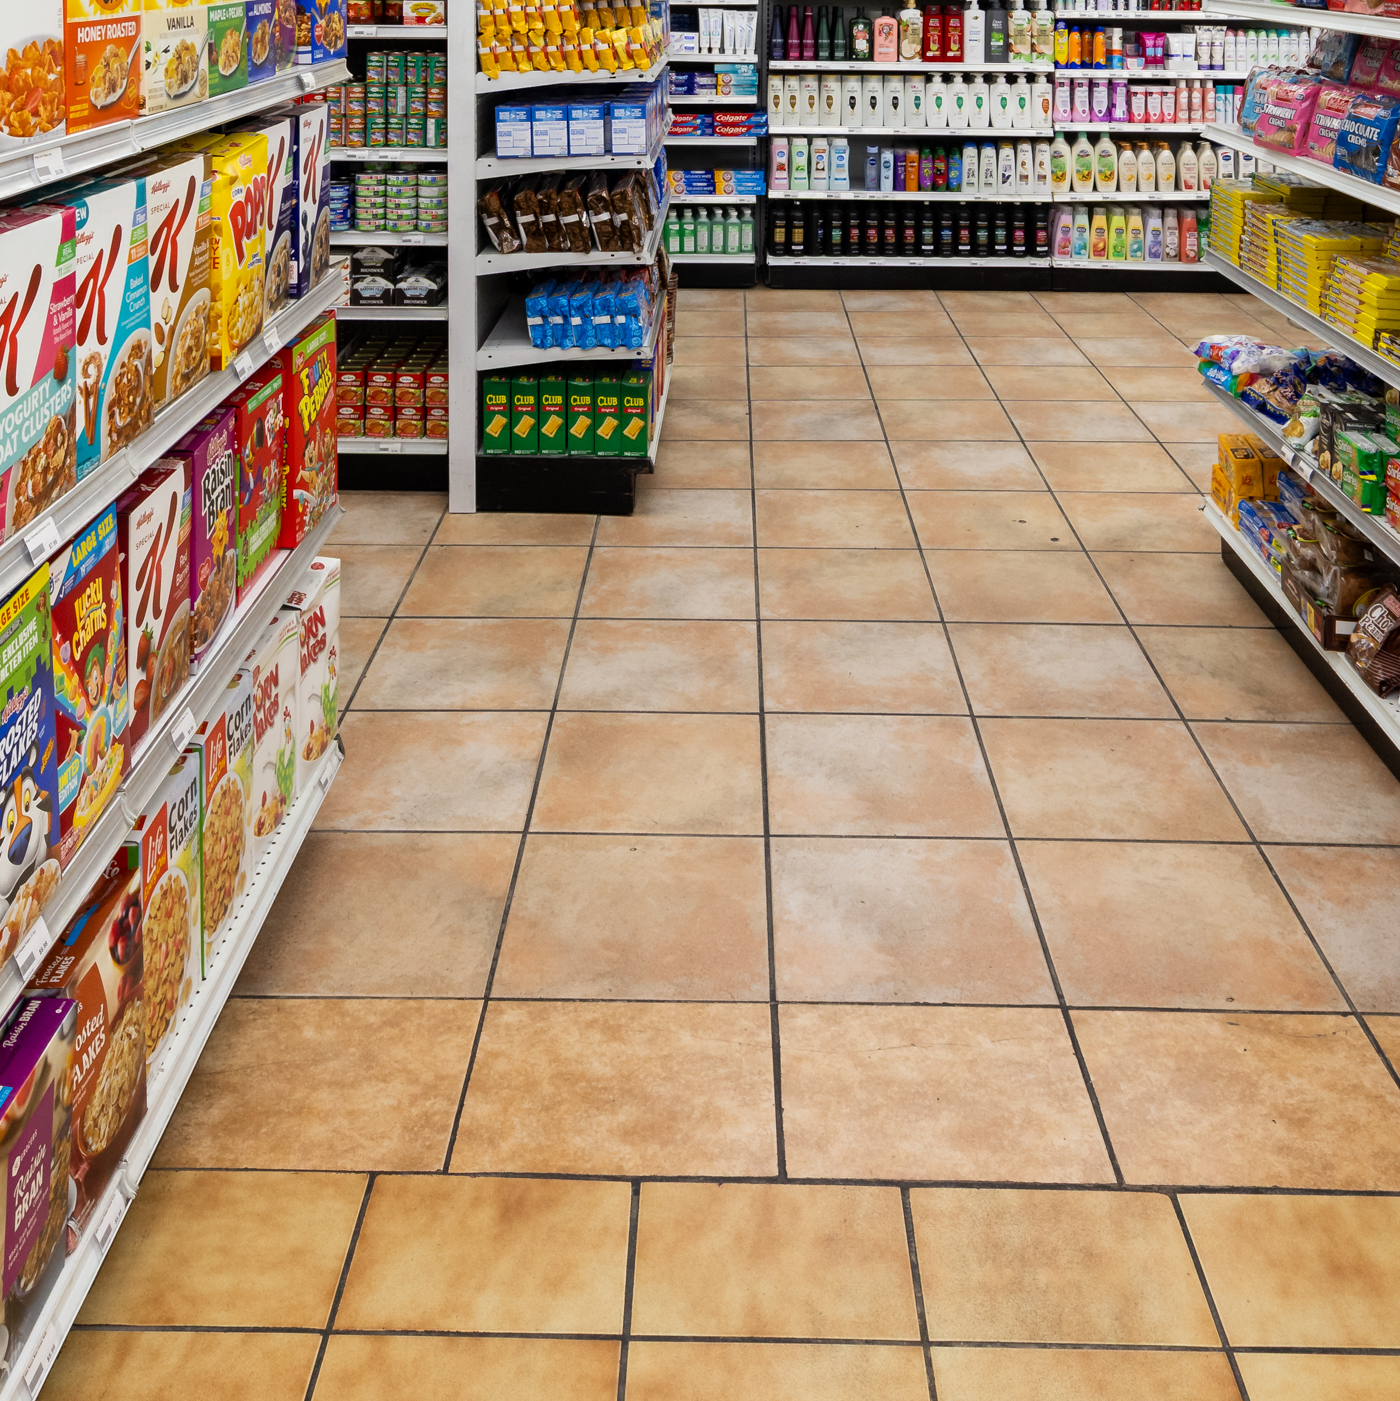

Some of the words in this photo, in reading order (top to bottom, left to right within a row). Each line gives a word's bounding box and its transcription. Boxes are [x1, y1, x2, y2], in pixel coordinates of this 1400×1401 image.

[210, 9, 226, 22] MAPLE
[229, 6, 243, 20] PECANS
[254, 3, 272, 16] ALMONDS
[76, 24, 104, 45] HONEY
[106, 20, 137, 40] ROASTED
[167, 16, 194, 30] VANILLA
[1341, 118, 1381, 141] CHOCOLATE
[21, 379, 72, 443] CLUSTERS
[486, 395, 507, 405] CLUB
[624, 396, 644, 407] CLUB
[74, 576, 103, 632] Lucky
[72, 603, 107, 661] Charms
[227, 691, 251, 739] Corn
